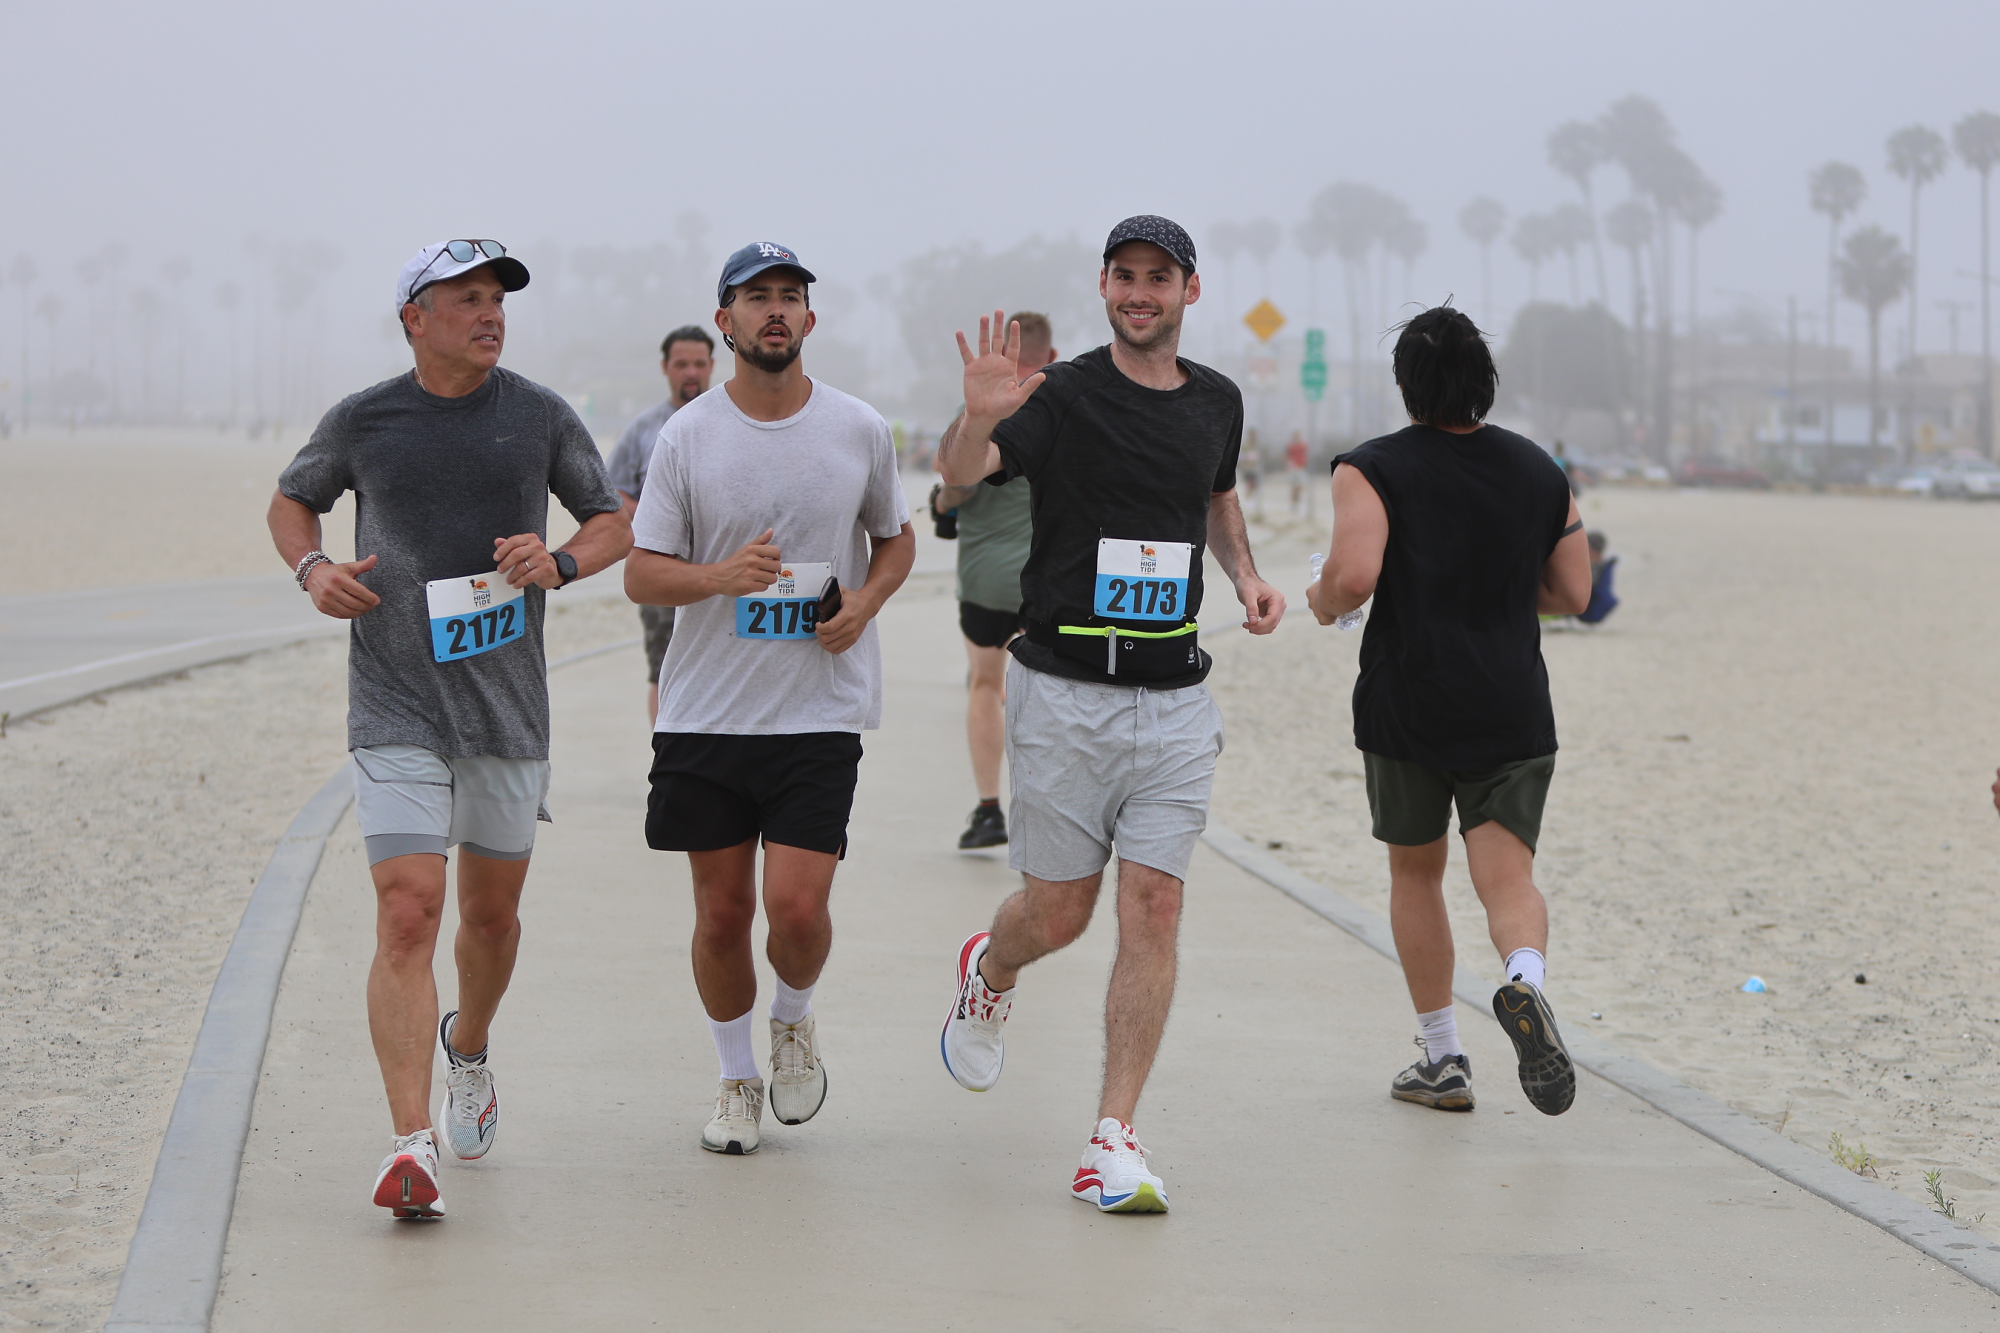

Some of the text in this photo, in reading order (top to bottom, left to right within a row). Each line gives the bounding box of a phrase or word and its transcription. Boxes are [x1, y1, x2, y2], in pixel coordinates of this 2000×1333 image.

[756, 242, 780, 257] LA
[473, 593, 491, 602] HIGH
[474, 599, 491, 607] TIDE
[1106, 578, 1178, 616] 2173
[748, 600, 819, 634] 2179
[446, 604, 515, 655] 2172
